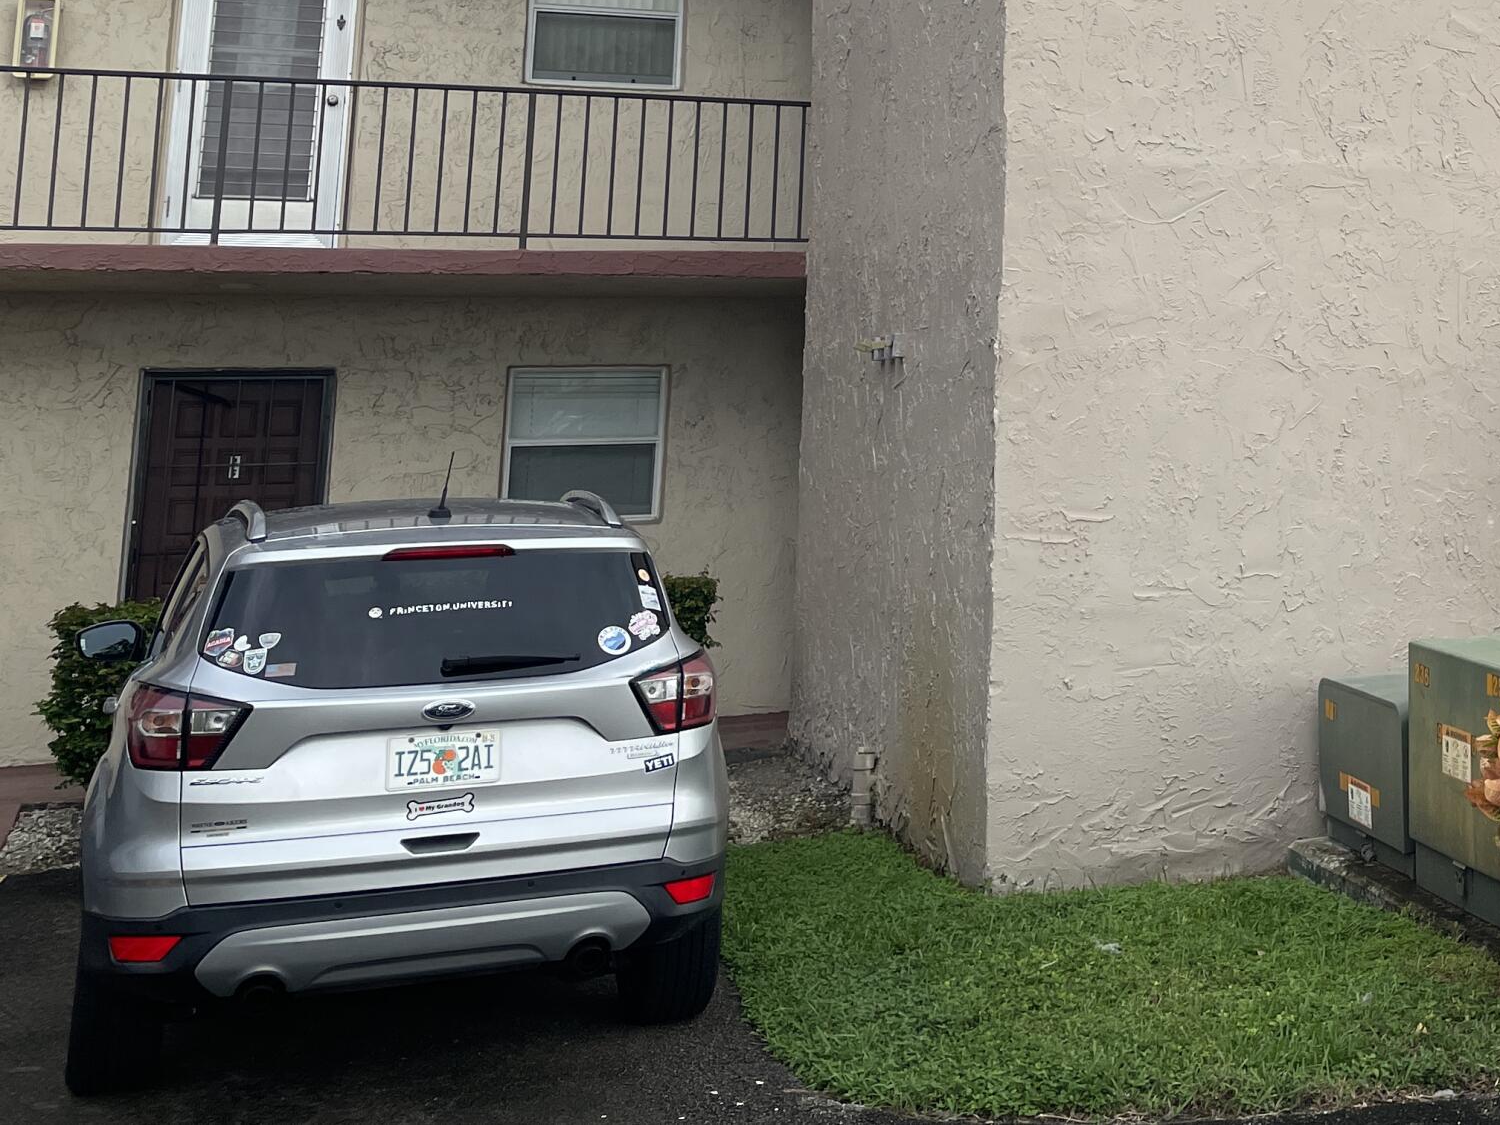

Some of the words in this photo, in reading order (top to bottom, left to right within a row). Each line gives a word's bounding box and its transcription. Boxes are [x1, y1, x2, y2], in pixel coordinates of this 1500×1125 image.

[389, 603, 451, 615] PRINCETON
[452, 600, 513, 611] UNIVERSITY
[645, 755, 674, 771] YETI
[413, 776, 439, 785] PALM
[442, 773, 475, 783] BEACH
